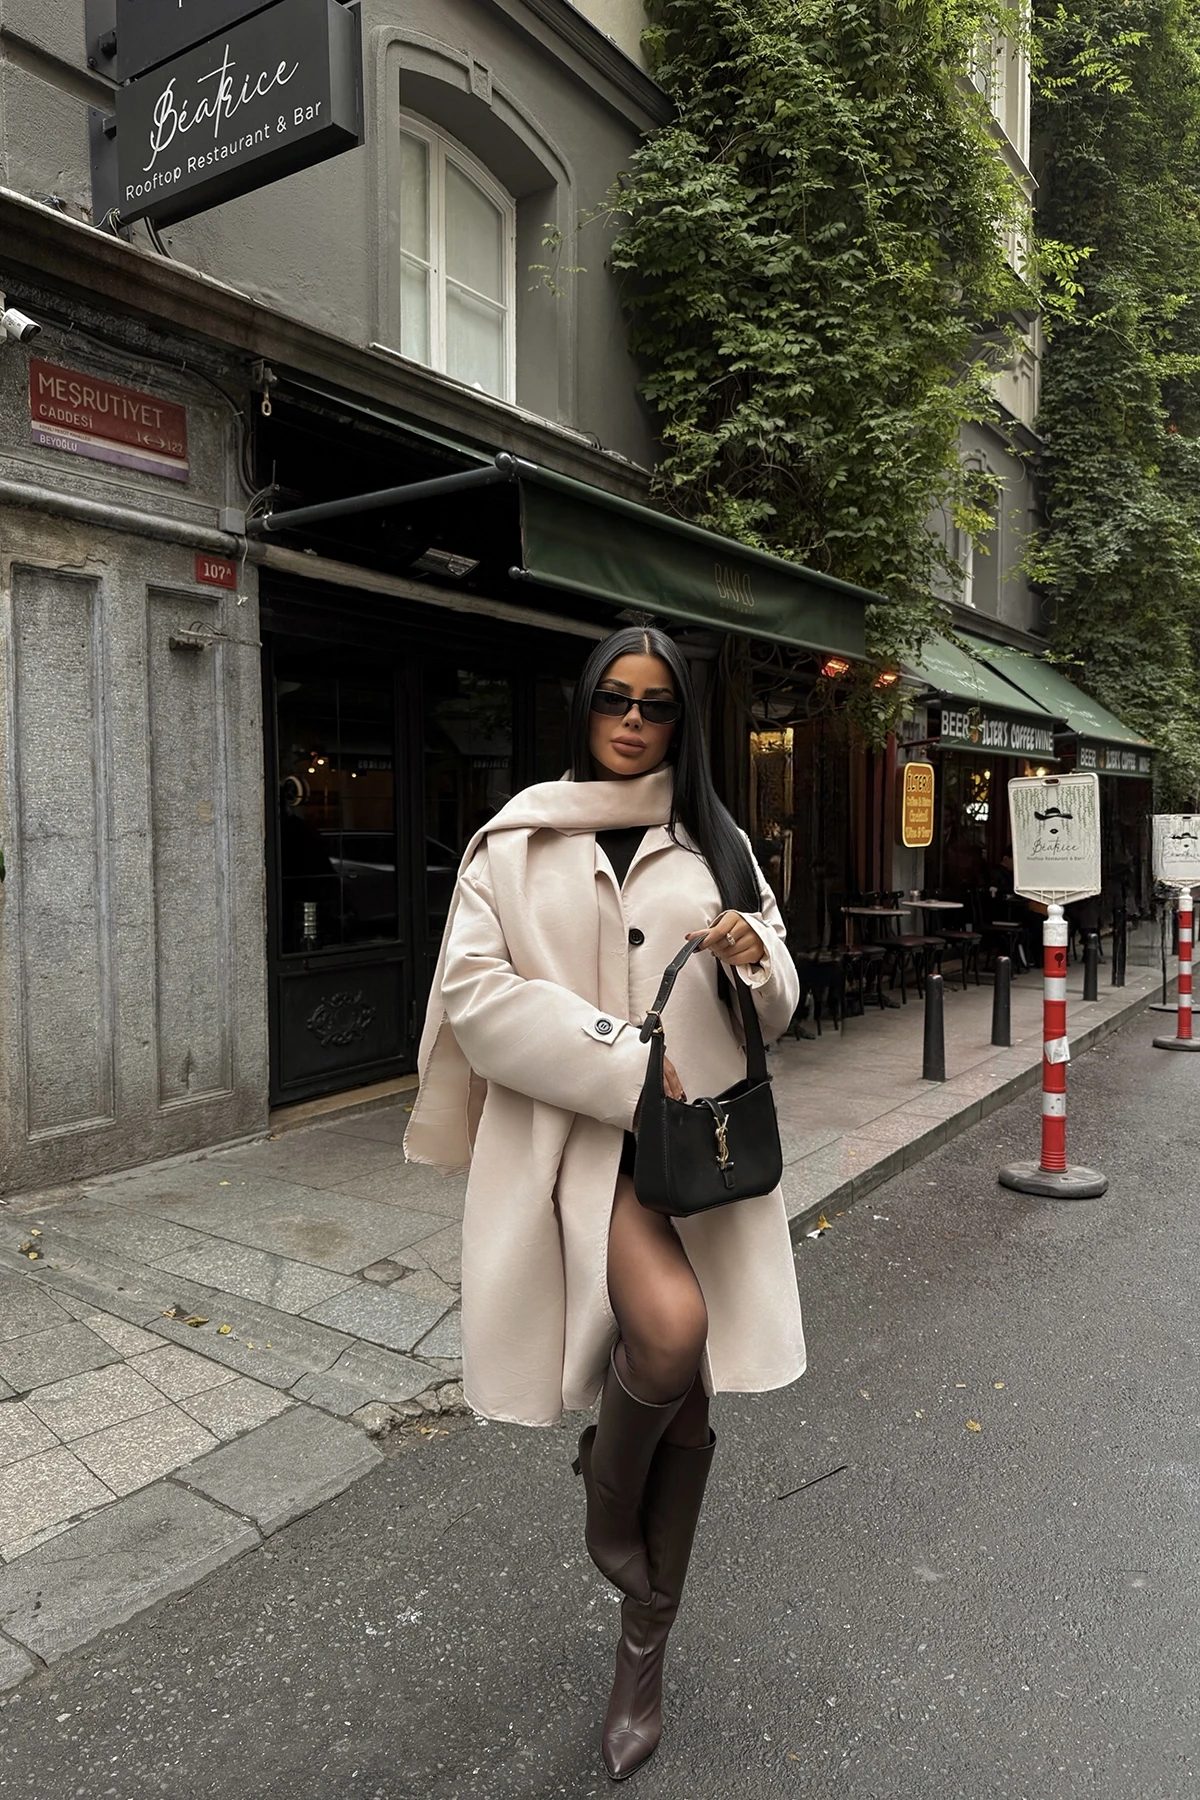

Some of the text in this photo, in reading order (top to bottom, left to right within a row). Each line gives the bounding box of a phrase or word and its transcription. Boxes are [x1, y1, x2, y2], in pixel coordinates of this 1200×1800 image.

[142, 44, 299, 172] Béatrice
[125, 101, 322, 201] Rooftop Restaurant & Bar
[38, 372, 164, 429] MEŞRUTİYET
[39, 403, 93, 429] CADDESİ
[39, 434, 77, 452] BEYOĞLU
[941, 710, 970, 738] BEER
[1010, 724, 1035, 751] COFFEE
[1034, 728, 1053, 751] WINE
[1080, 747, 1097, 768] BEER
